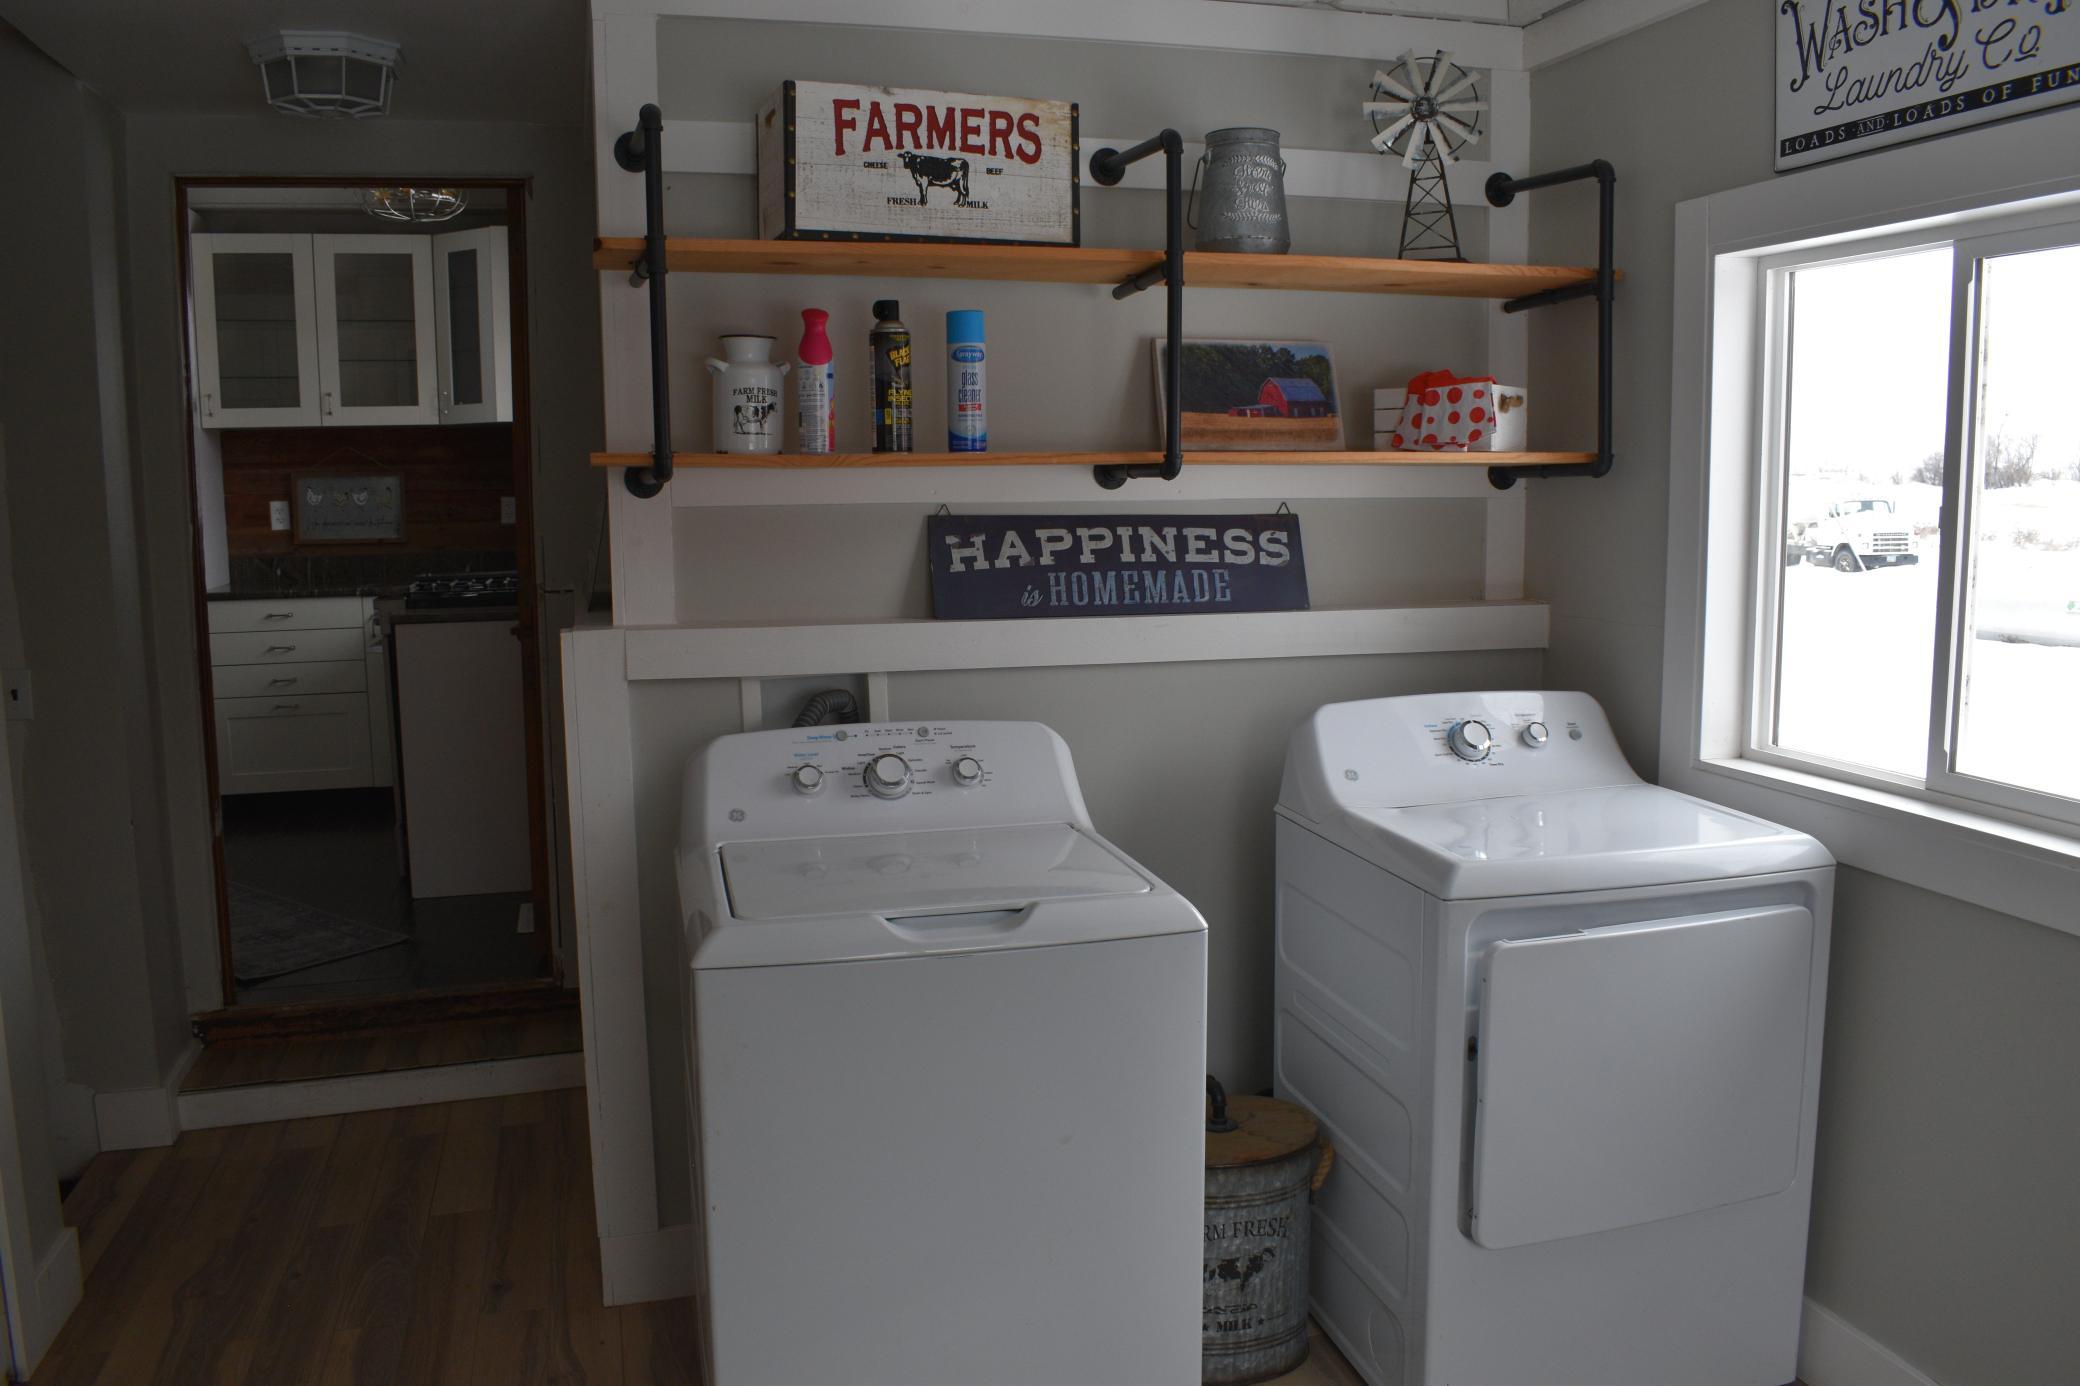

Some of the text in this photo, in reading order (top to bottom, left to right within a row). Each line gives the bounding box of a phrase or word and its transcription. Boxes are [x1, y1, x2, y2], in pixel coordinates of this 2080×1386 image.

[1814, 42, 1969, 115] Laundry
[1785, 69, 2080, 154] LOADS AND LOADS OF FUN
[832, 99, 1042, 164] FARMERS
[887, 196, 989, 209] FRESH MILK
[732, 387, 755, 396] FARM
[746, 395, 767, 404] MILK
[944, 526, 1291, 573] HAPPINESS
[1020, 569, 1232, 608] is HOMEMADE
[1232, 1216, 1289, 1239] FRESH
[1216, 1318, 1252, 1333] MILK
